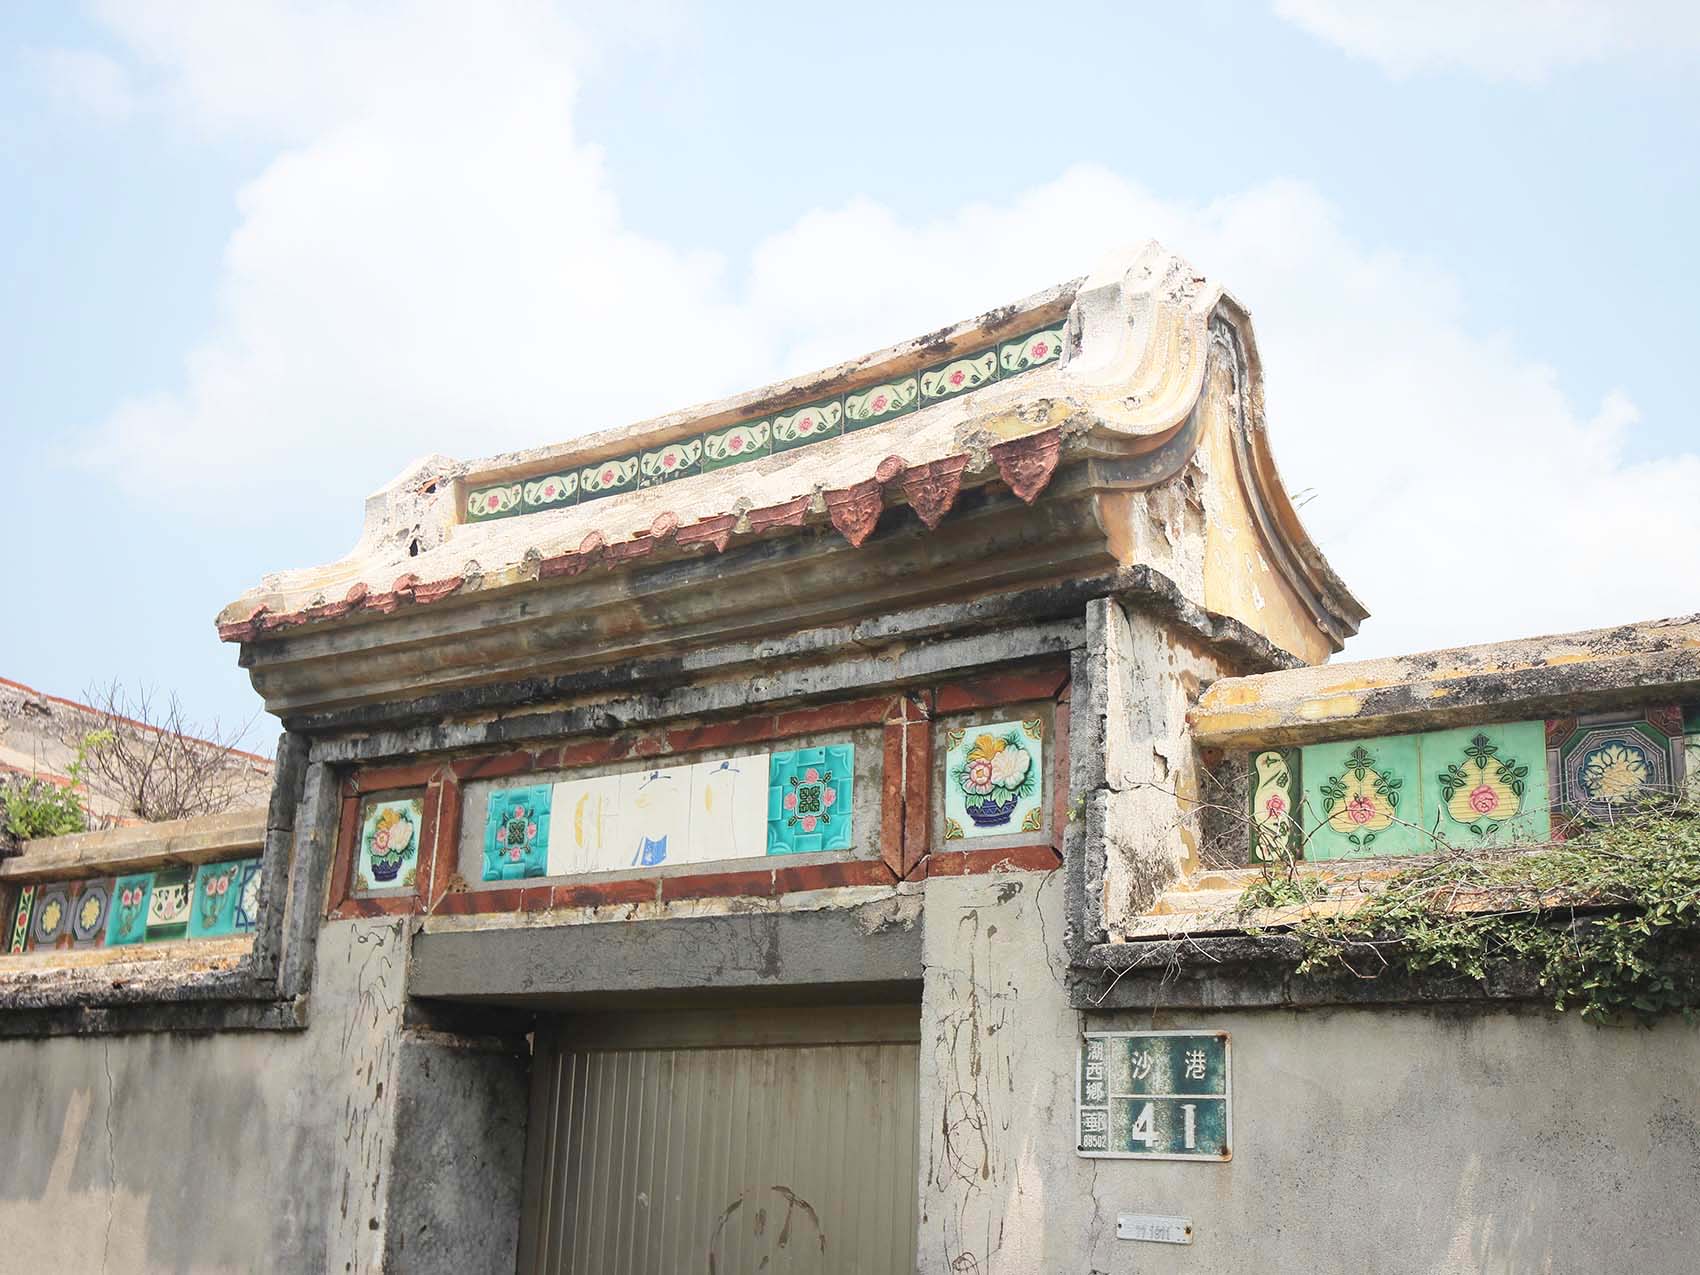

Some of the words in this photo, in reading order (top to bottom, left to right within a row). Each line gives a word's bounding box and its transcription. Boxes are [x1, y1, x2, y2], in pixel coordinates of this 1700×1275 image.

[1086, 1040, 1105, 1101] 湖西鄉
[1132, 1050, 1206, 1079] 沙港
[1132, 1102, 1197, 1149] 41
